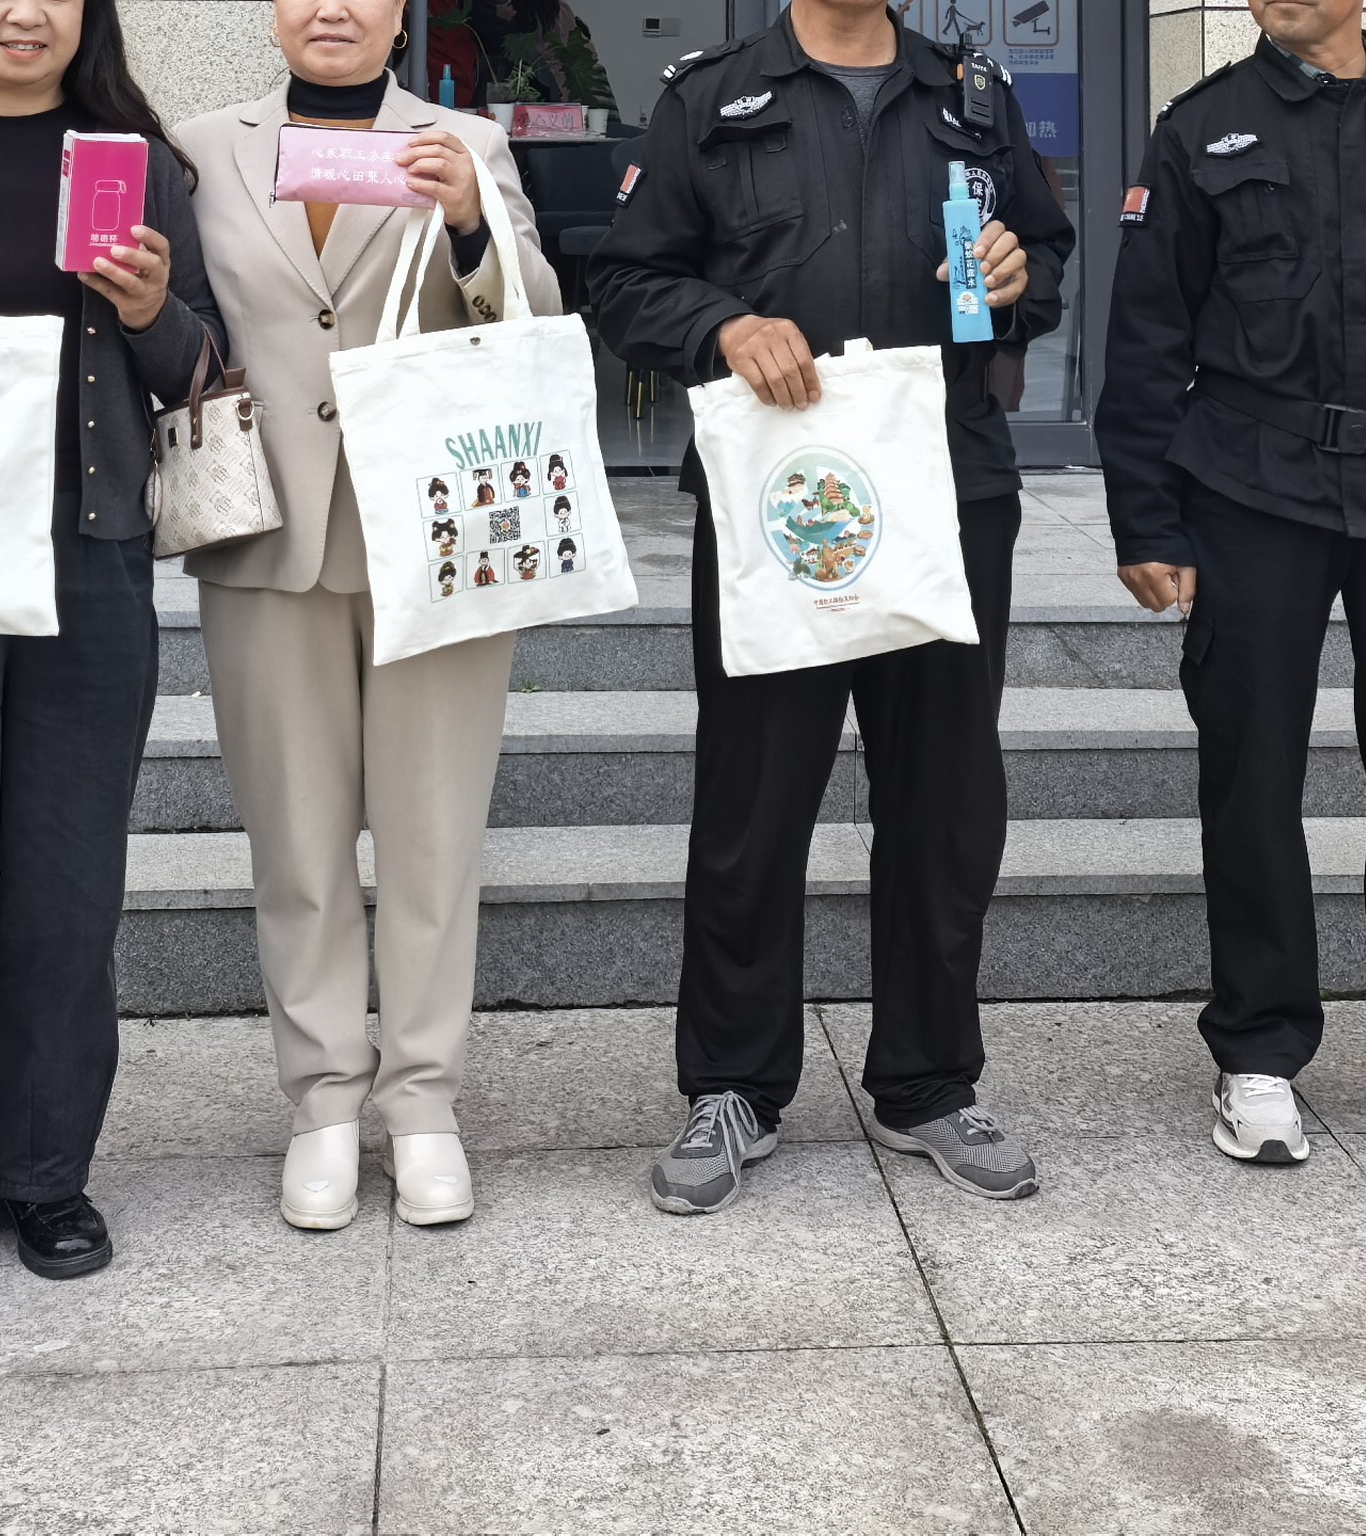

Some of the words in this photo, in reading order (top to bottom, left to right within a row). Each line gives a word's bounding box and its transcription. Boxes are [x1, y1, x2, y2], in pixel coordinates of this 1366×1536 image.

[311, 148, 401, 162] 心系职工办实
[445, 420, 542, 470] SHAANXI
